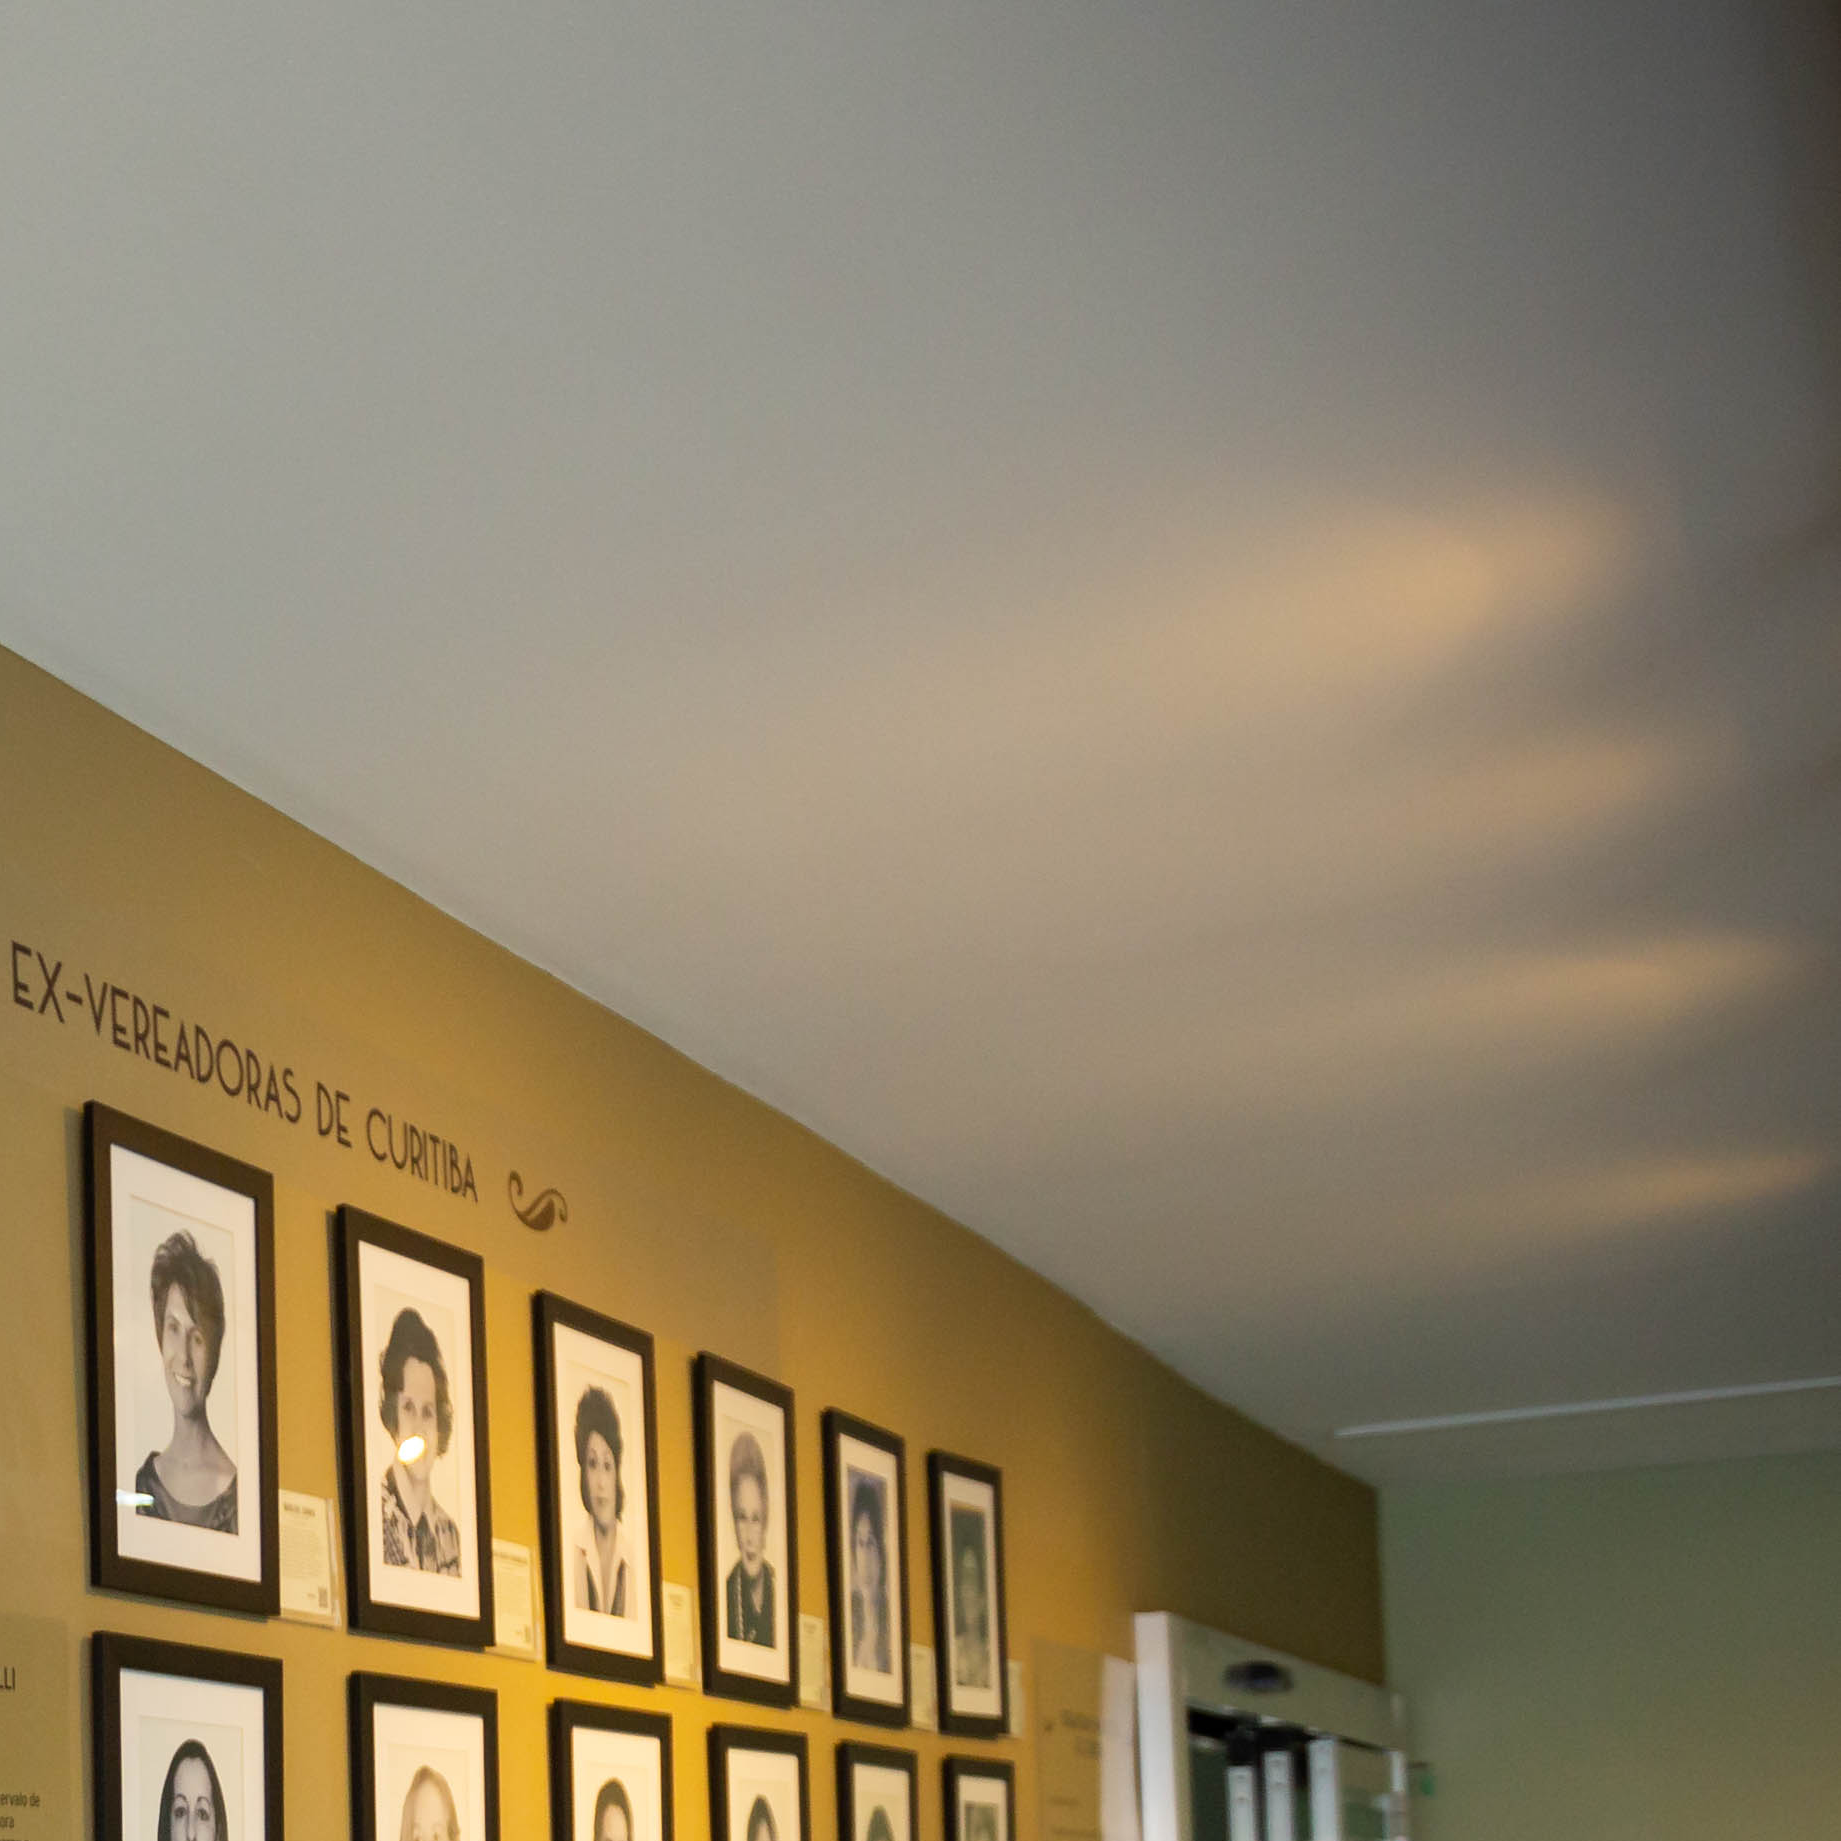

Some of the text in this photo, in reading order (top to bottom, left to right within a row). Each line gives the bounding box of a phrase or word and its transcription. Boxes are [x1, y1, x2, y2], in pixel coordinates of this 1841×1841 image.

[11, 940, 478, 1205] EX-VEREADORAS DE CURITIBA
